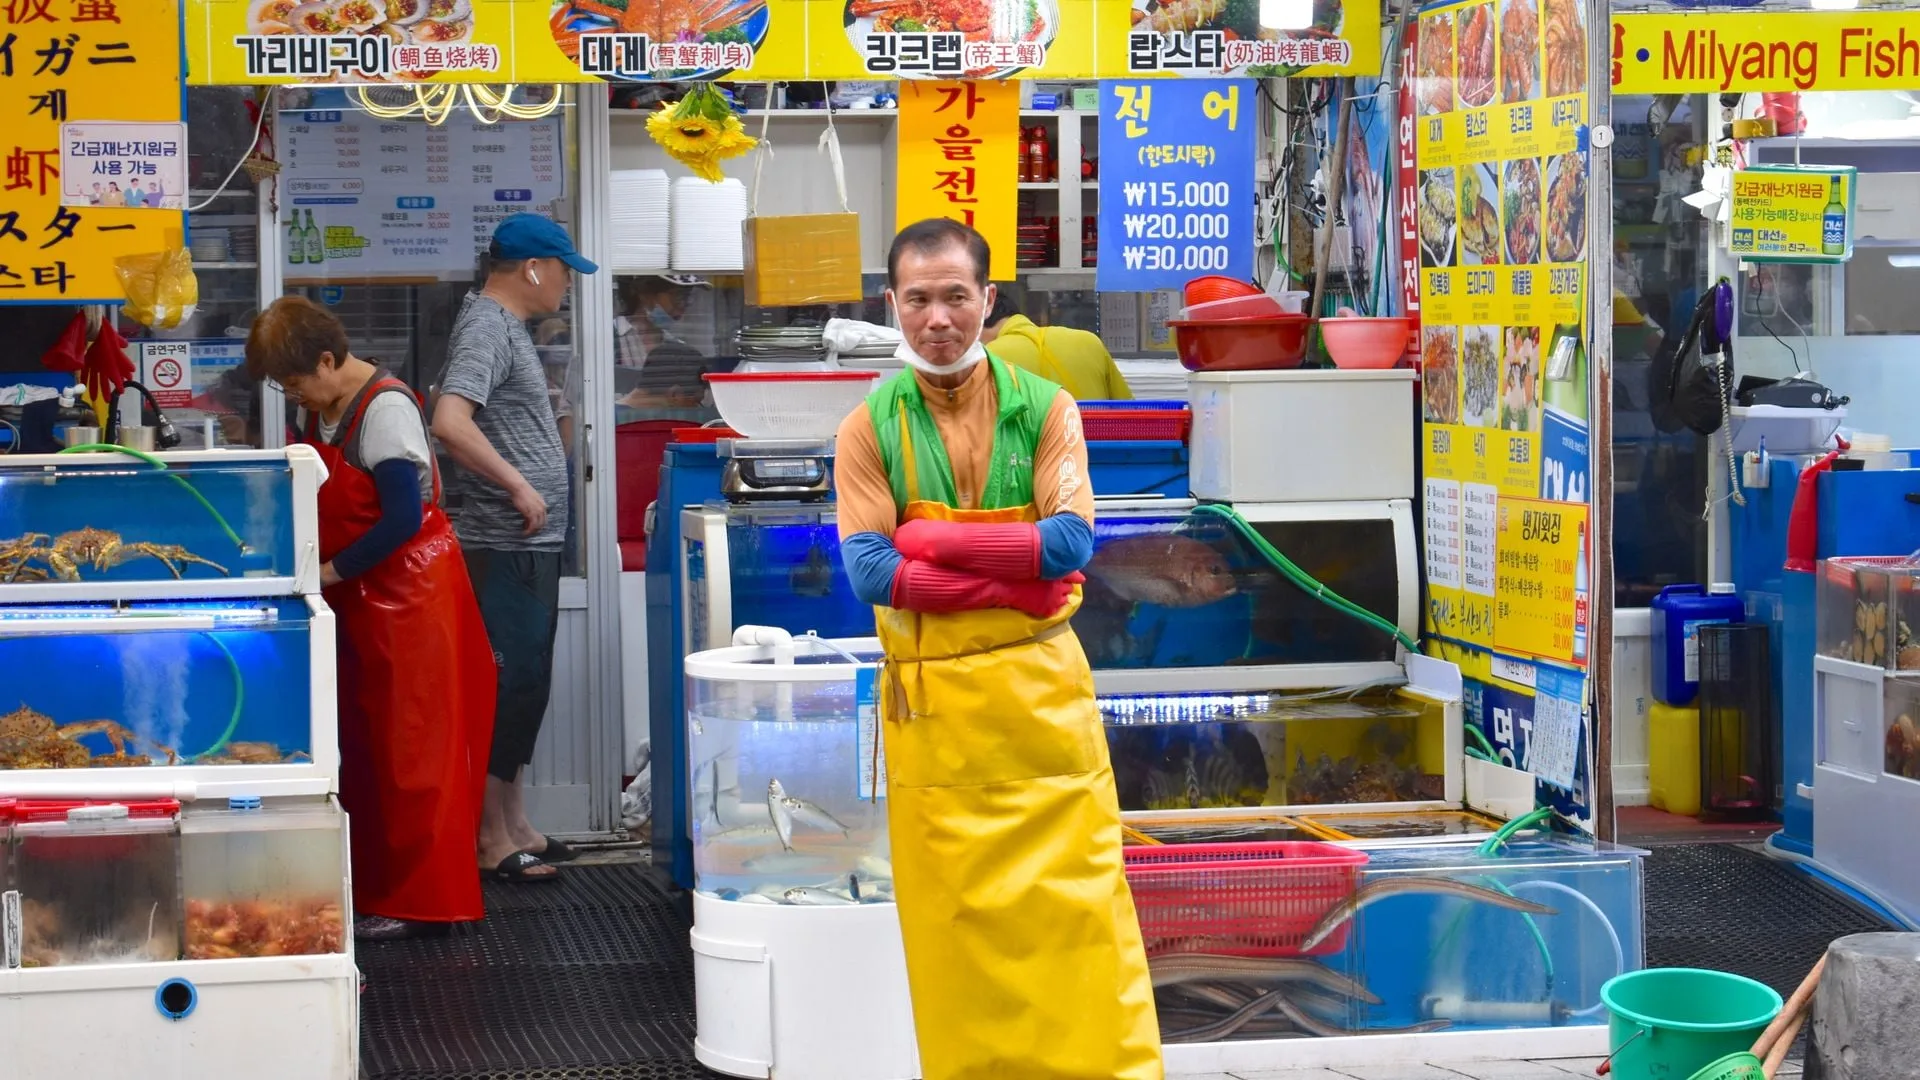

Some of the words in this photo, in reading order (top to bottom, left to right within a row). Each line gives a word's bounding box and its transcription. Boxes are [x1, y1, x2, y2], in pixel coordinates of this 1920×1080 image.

[236, 37, 389, 75] 가리비구이
[582, 36, 647, 71] 대게
[866, 35, 962, 71] 킹크랩
[1130, 34, 1225, 70] 랍스타
[1663, 29, 1818, 90] Milyang
[1839, 27, 1920, 78] Fish
[71, 141, 178, 157] 긴급재난지원금
[932, 80, 986, 229] 가을전
[1138, 145, 1216, 168] (한도시락)
[92, 161, 122, 175] 사용
[127, 161, 157, 175] 가능
[1123, 182, 1230, 208] ₩15,000
[1735, 181, 1824, 198] 긴급재난지원금
[1123, 213, 1229, 239] ₩20,000
[1733, 207, 1798, 221] 사용가능매장
[1824, 221, 1843, 230] 대선
[1122, 245, 1229, 271] ₩30,000
[146, 344, 187, 355] 금연구역
